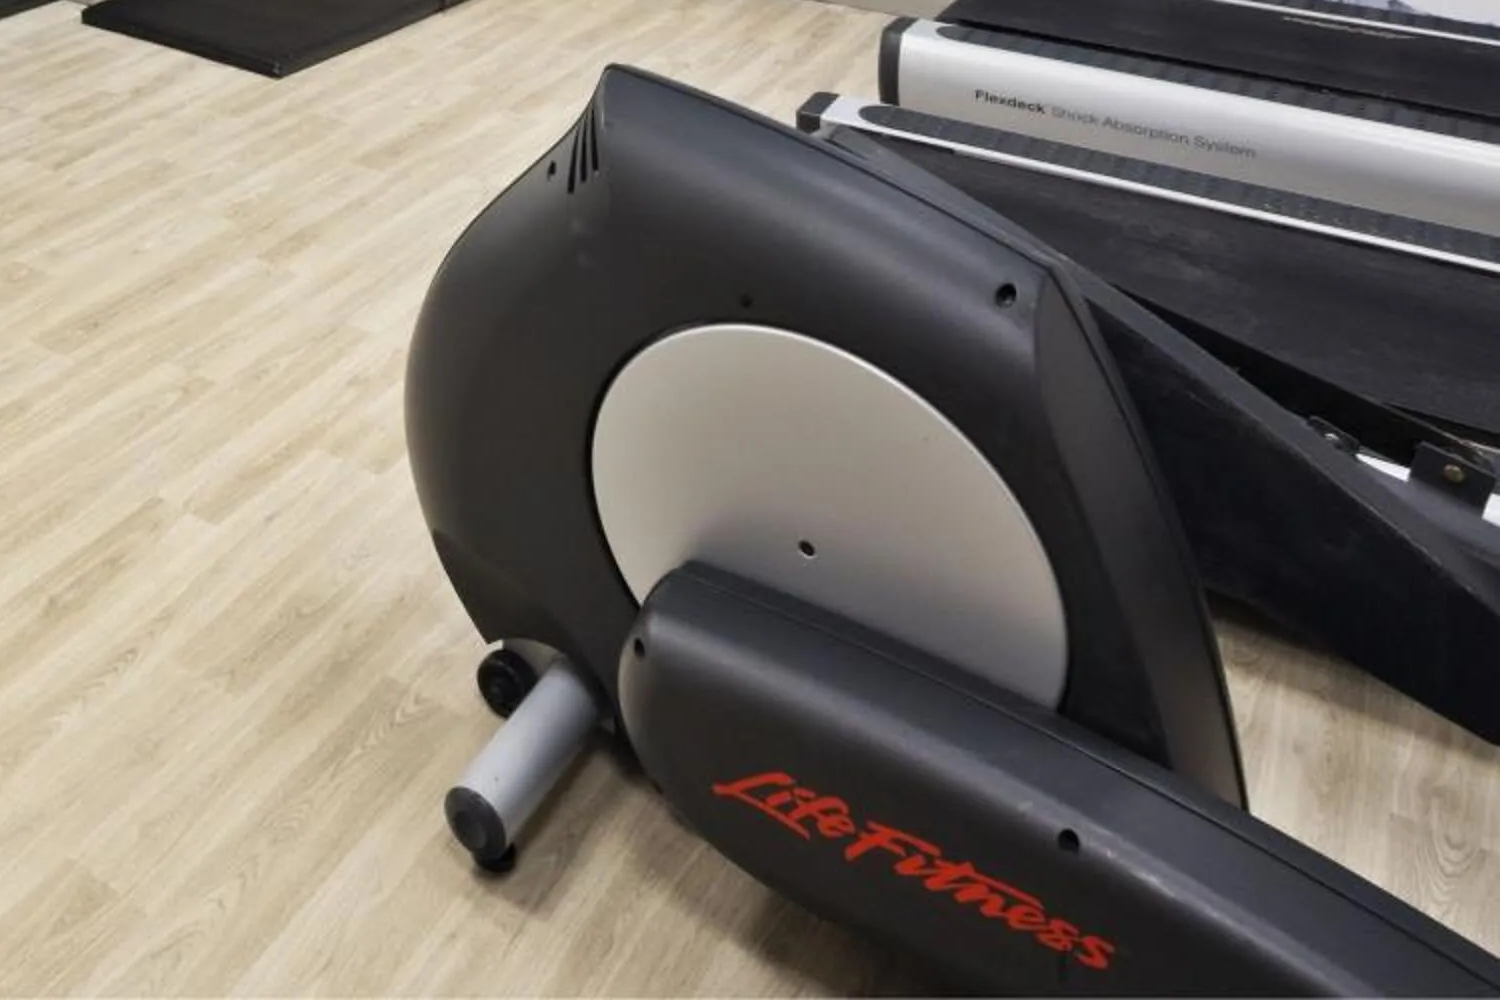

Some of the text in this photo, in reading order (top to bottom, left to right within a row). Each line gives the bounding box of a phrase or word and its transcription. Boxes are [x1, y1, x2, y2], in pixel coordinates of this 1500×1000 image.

[973, 88, 1258, 160] Flexdeck Shock Absorption System
